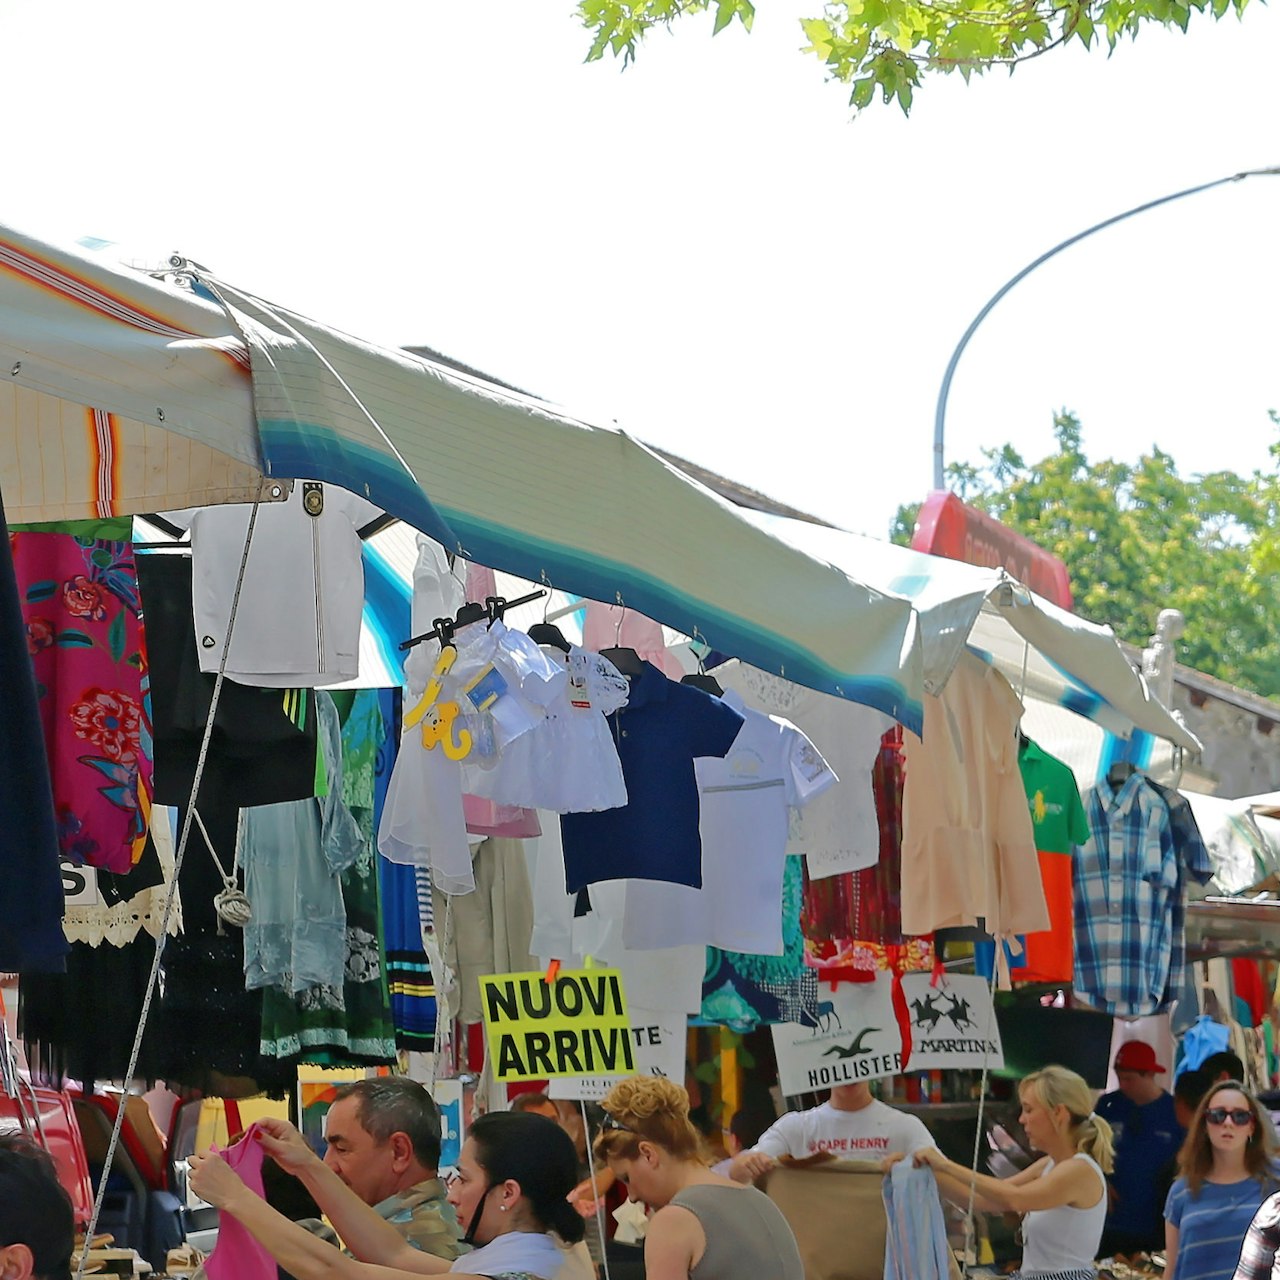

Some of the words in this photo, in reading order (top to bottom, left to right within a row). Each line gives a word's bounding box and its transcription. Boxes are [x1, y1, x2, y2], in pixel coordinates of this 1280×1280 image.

[485, 976, 623, 1022] NUOVI
[498, 1028, 633, 1077] ARRIVI
[919, 1040, 998, 1055] MARTINA
[808, 1053, 902, 1087] HOLLISTER
[850, 1137, 889, 1149] HENRY
